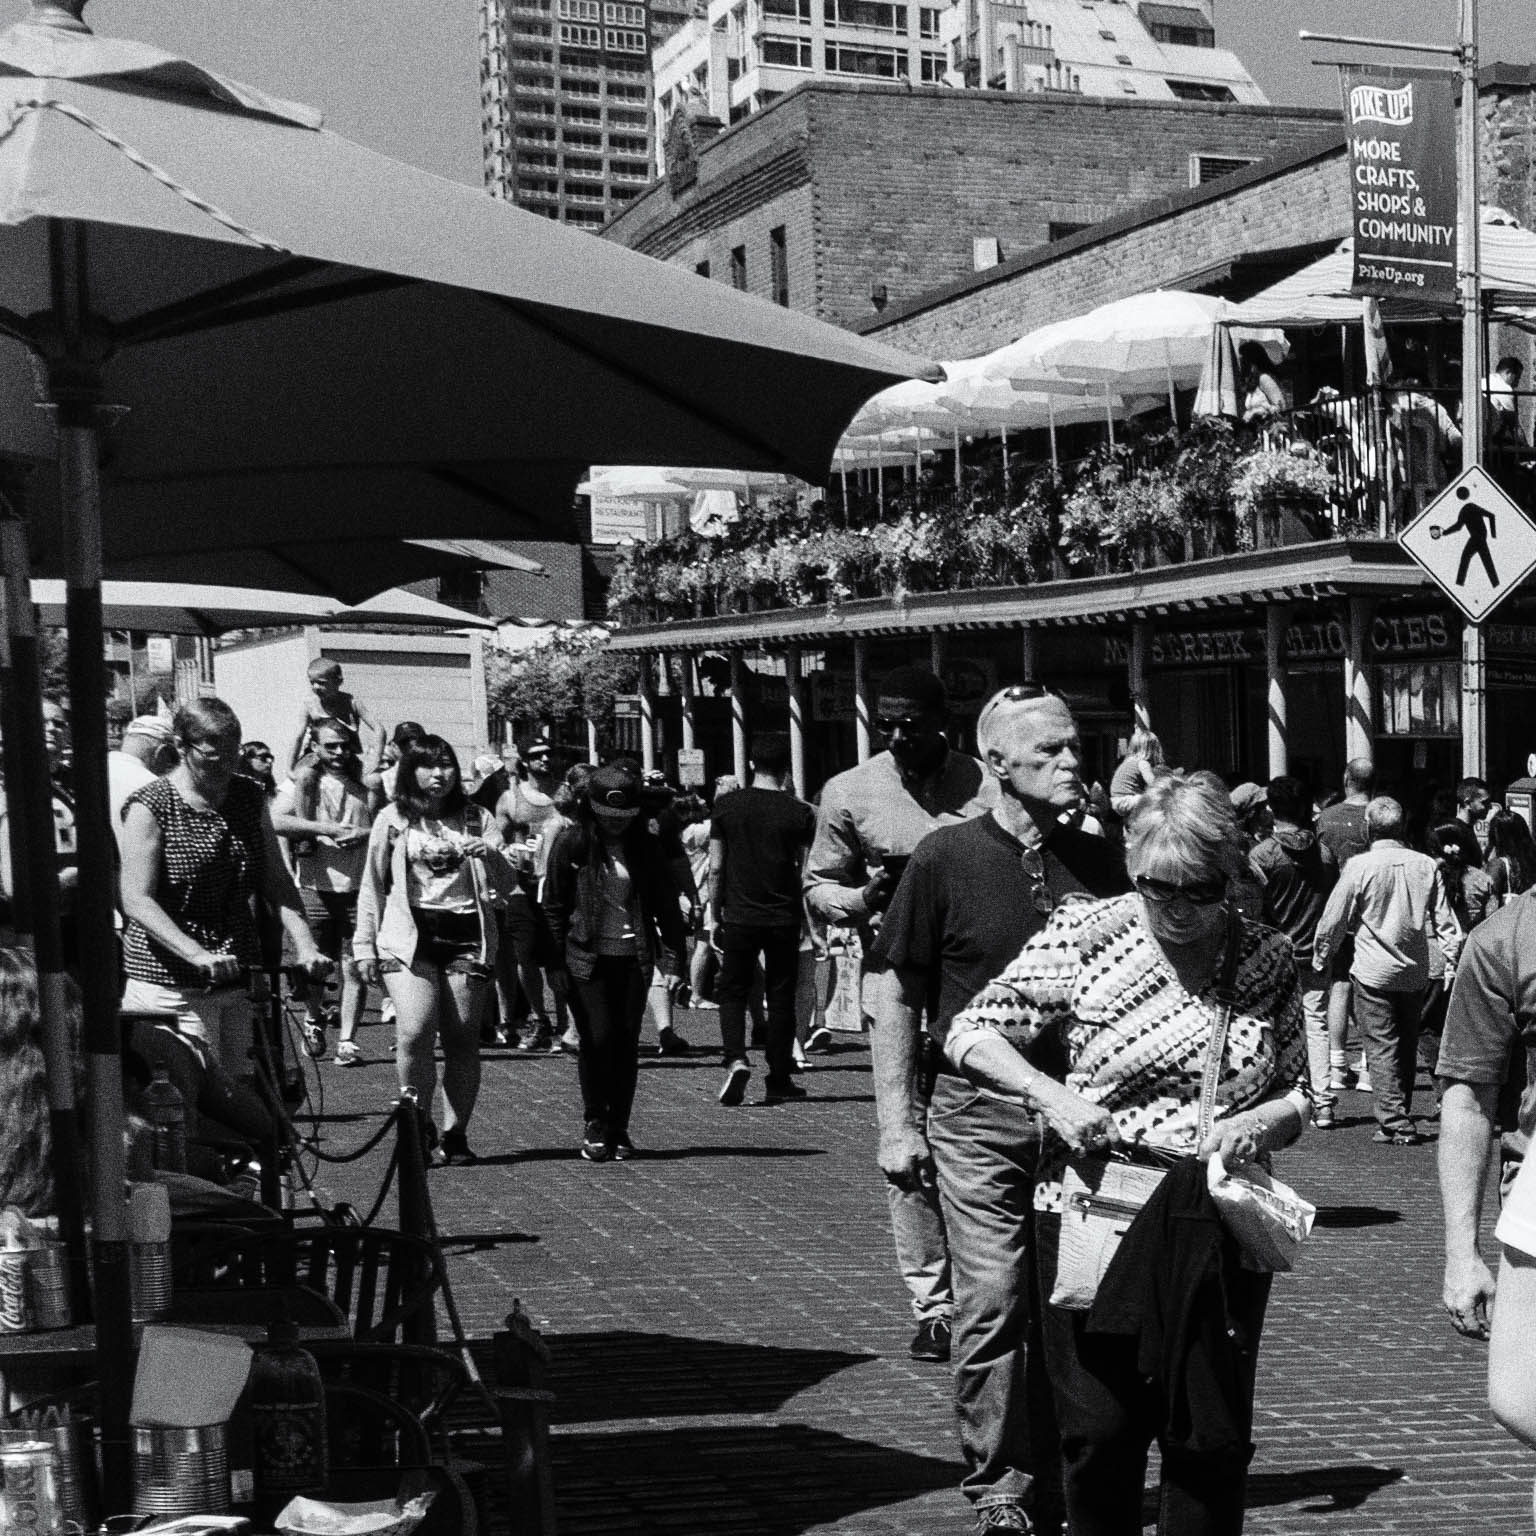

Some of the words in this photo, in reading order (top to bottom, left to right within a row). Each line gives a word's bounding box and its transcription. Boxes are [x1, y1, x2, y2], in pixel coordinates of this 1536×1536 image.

[1351, 90, 1386, 117] PIKE
[1387, 91, 1413, 120] UP!
[1353, 139, 1401, 161] MORE
[1356, 166, 1420, 191] CRAFTS,
[1358, 192, 1410, 215] SHOPS
[1414, 197, 1426, 217] &
[1359, 218, 1453, 246] COMMUNITY
[1359, 264, 1424, 286] PikeUp.org
[1167, 631, 1250, 665] GREEK
